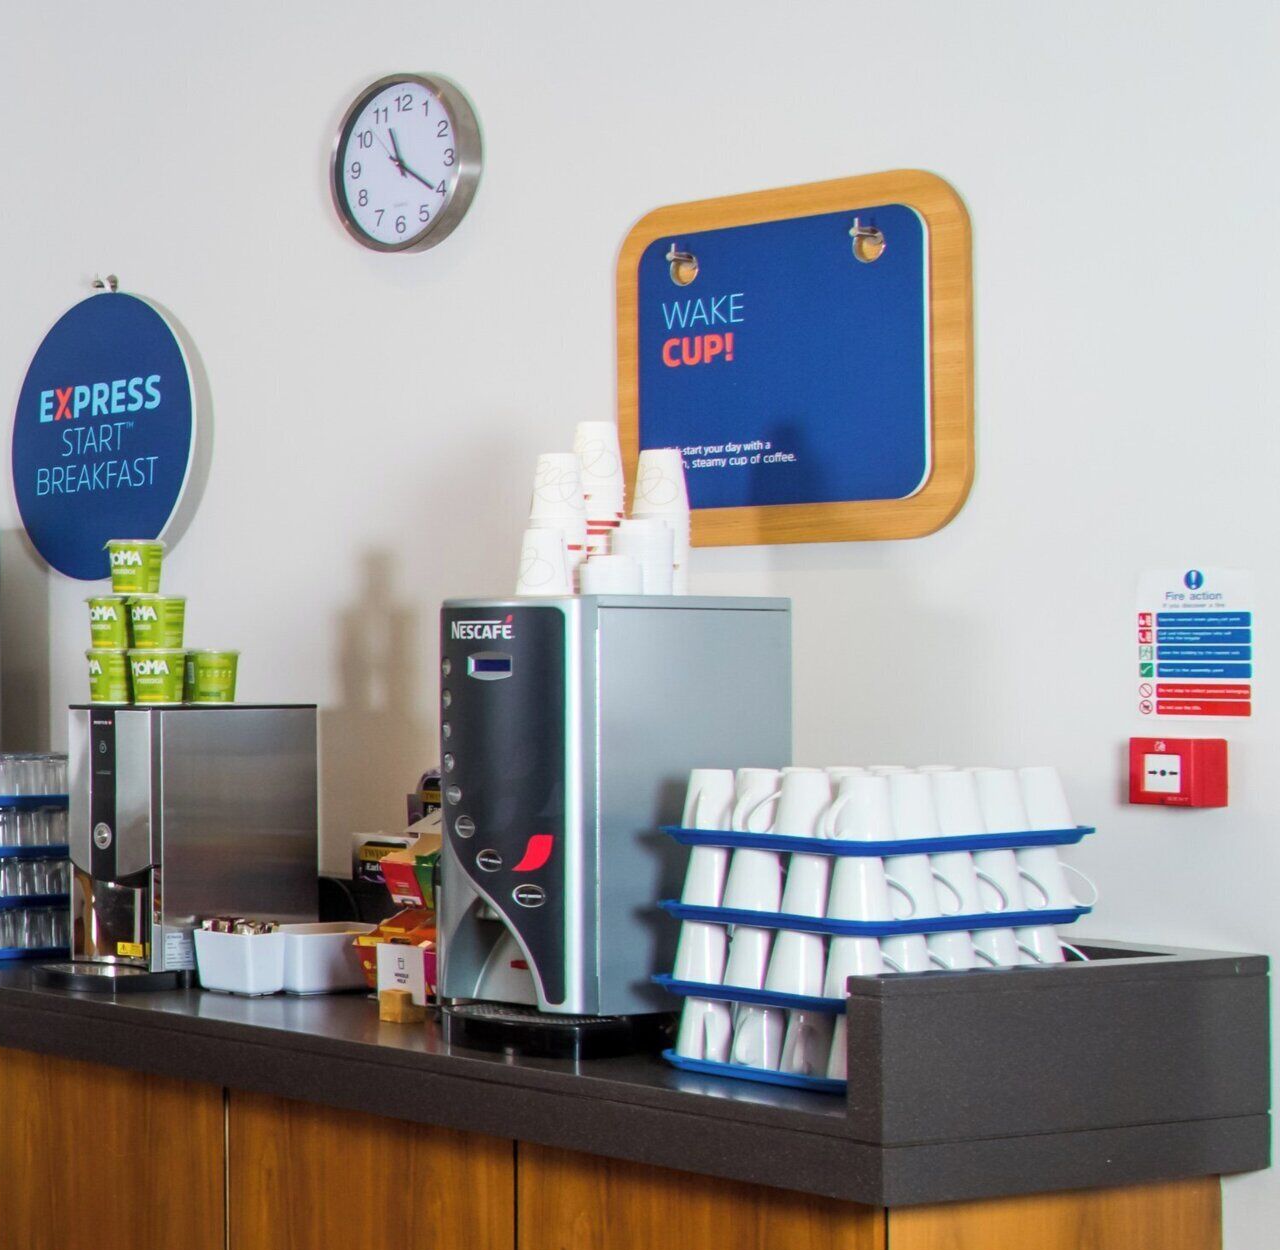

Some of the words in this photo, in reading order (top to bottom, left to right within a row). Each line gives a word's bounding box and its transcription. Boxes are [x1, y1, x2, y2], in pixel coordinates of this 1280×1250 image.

[394, 94, 413, 112] 12
[422, 101, 429, 116] 1
[373, 107, 388, 124] 11
[437, 120, 449, 138] 2
[357, 130, 373, 149] 10
[443, 148, 455, 167] 3
[351, 162, 361, 179] 9
[436, 180, 447, 197] 4
[358, 189, 368, 207] 8
[374, 209, 385, 226] 7
[419, 204, 430, 222] 5
[395, 216, 406, 233] 6
[662, 292, 744, 330] WAKE
[662, 332, 734, 368] CUP!
[40, 374, 161, 423] EXPRESS
[704, 445, 723, 456] your
[725, 442, 741, 454] day
[743, 440, 763, 451] with
[765, 441, 772, 450] a
[692, 456, 727, 469] steamy
[729, 455, 747, 467] cup
[750, 453, 761, 464] of
[763, 451, 797, 463] coffee.
[36, 456, 159, 496] BREAKFAST
[1165, 591, 1185, 601] Fire
[1189, 591, 1223, 601] action
[451, 614, 513, 640] NESCAFÉ
